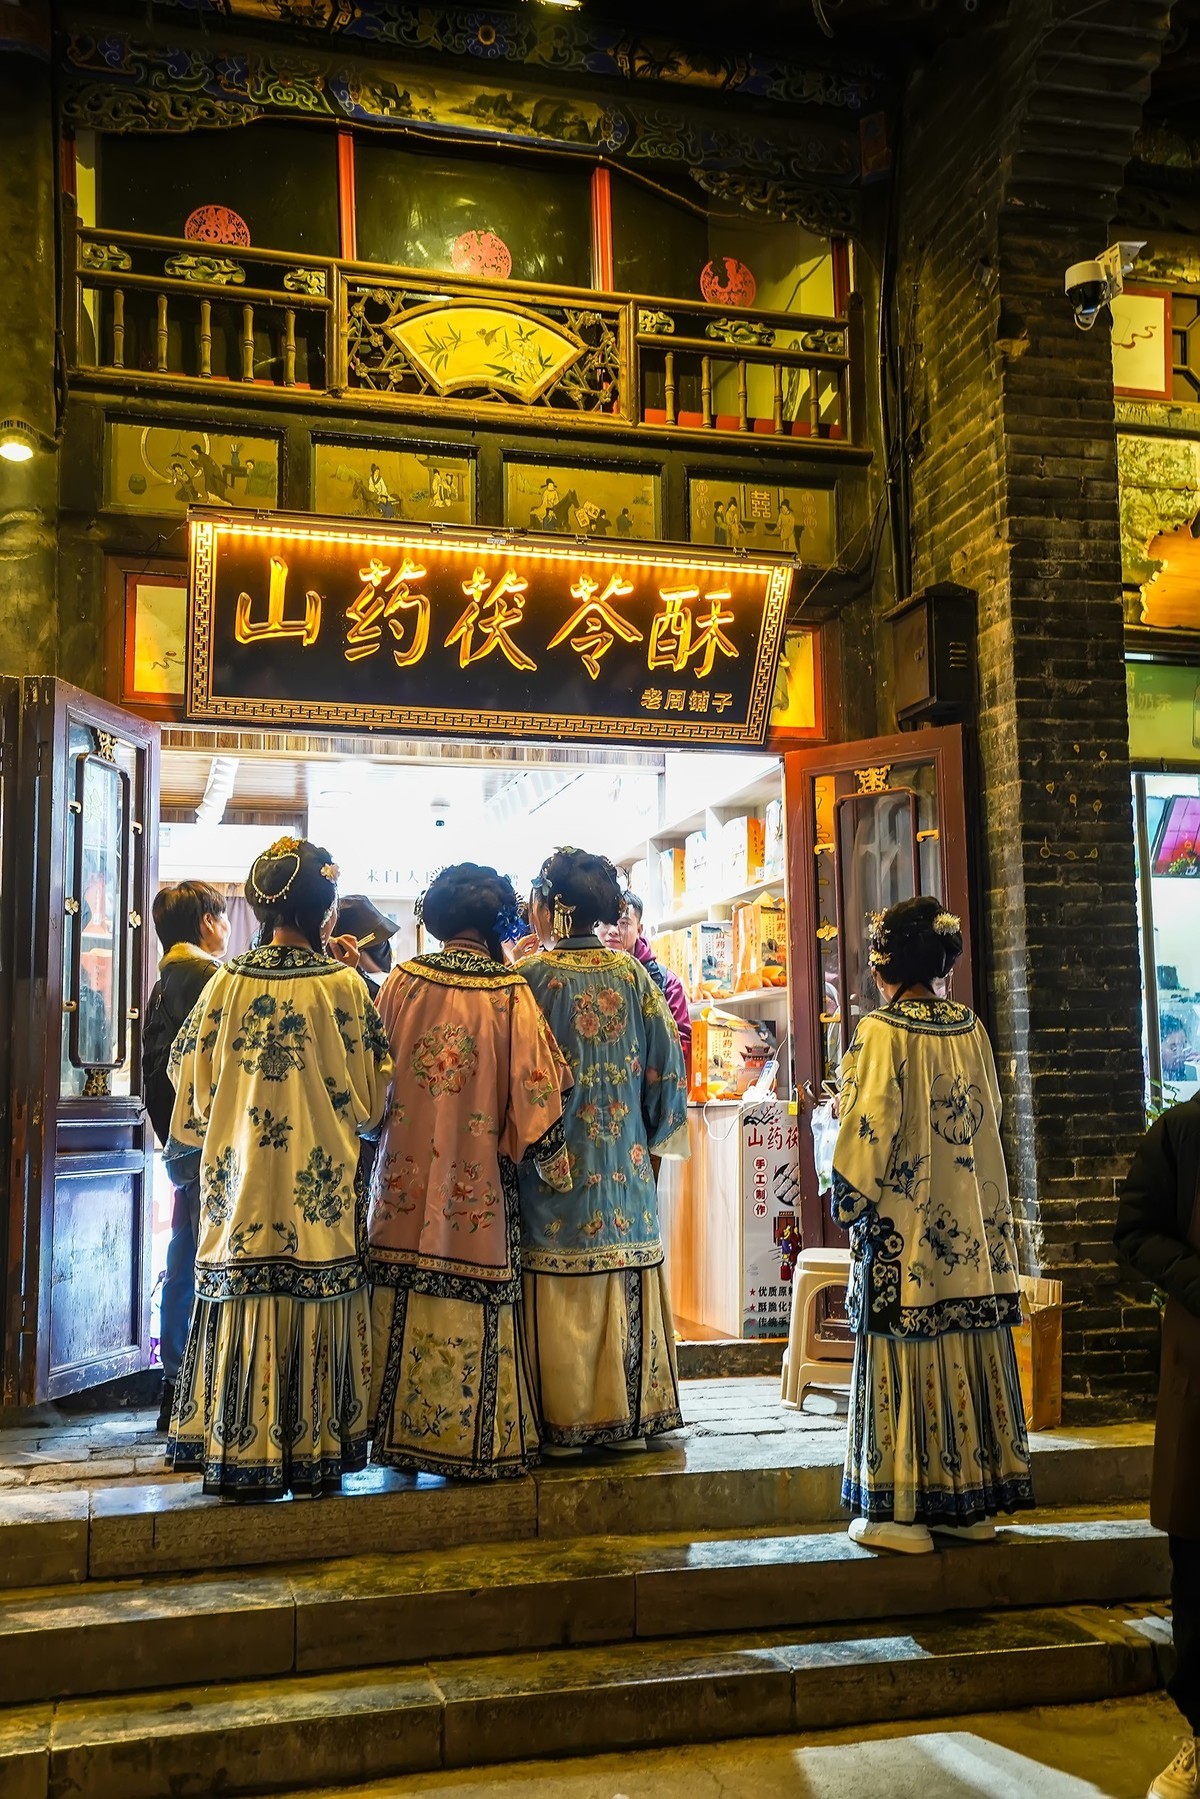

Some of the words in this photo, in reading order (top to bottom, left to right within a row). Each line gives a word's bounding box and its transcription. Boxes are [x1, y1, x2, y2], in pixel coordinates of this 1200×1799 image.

[234, 555, 740, 680] 山药茯苓酥
[640, 687, 733, 713] 老周铺子
[747, 1126, 799, 1151] 山药茯
[755, 1158, 766, 1216] 手工制作
